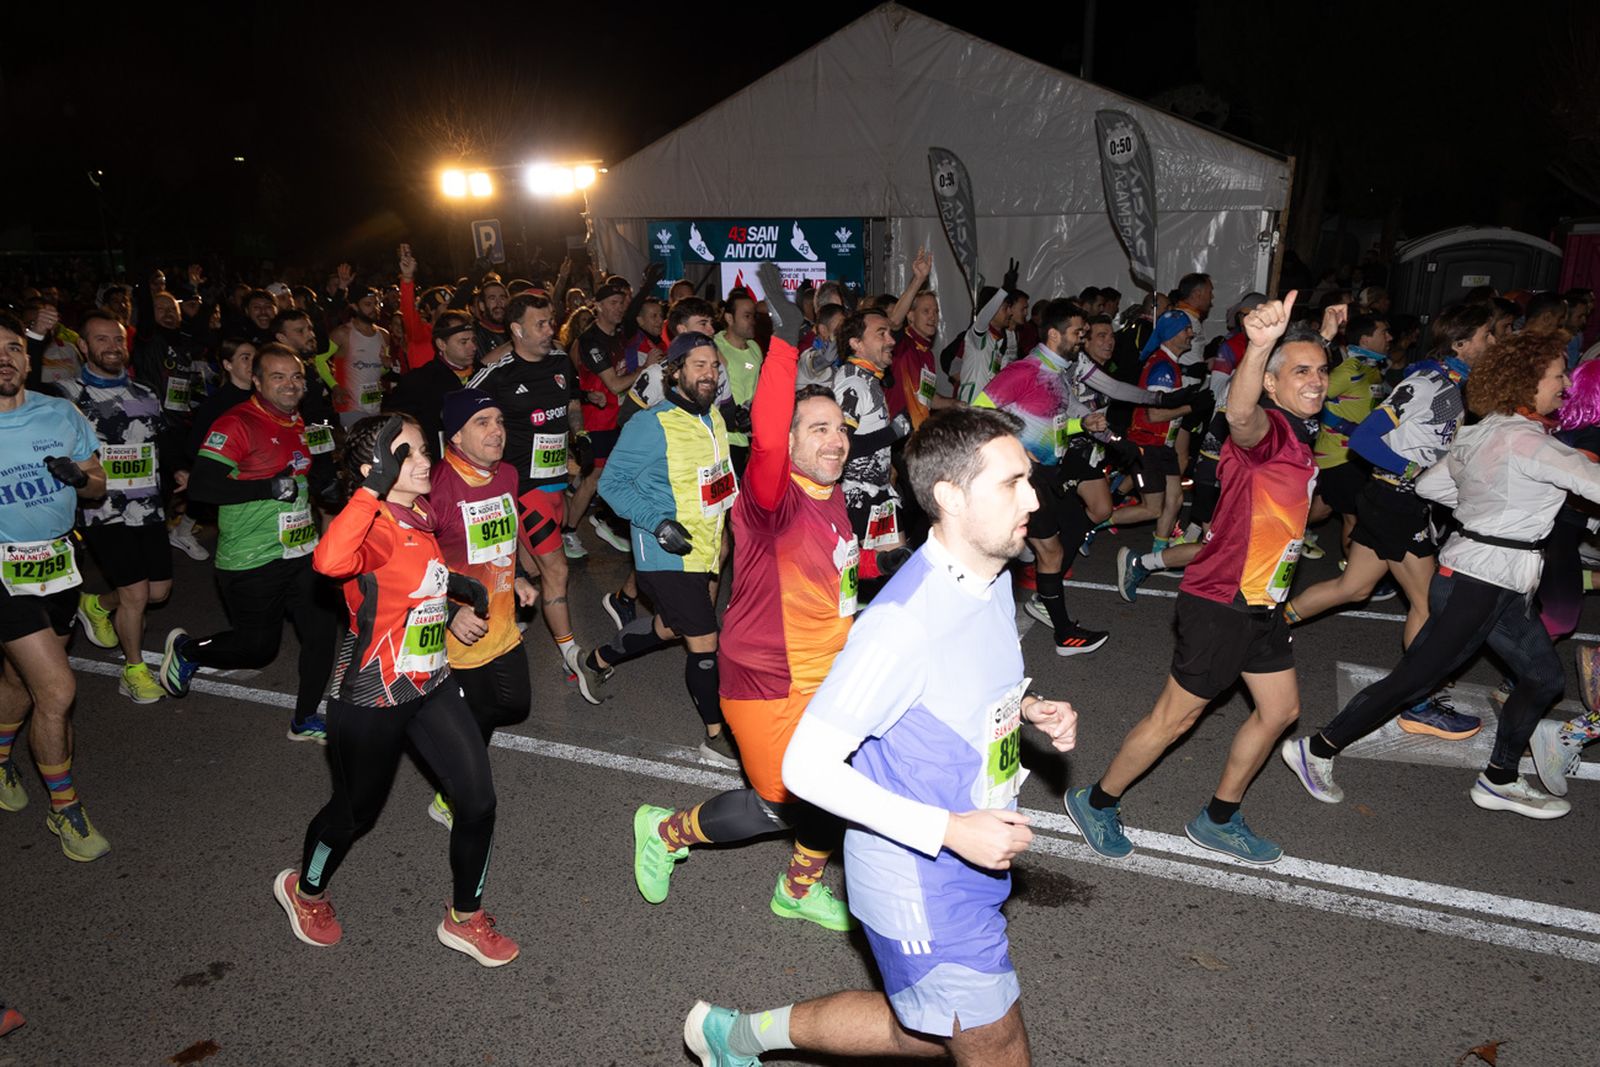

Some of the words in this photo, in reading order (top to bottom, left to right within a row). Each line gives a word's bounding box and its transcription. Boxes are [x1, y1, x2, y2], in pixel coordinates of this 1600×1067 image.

[1109, 136, 1132, 156] 0:50
[479, 225, 497, 254] P
[728, 225, 747, 243] 43
[747, 226, 779, 241] SAN
[724, 239, 777, 258] ANTÓN
[532, 413, 546, 423] TD
[545, 405, 567, 421] SPORT
[112, 459, 146, 475] 6067
[481, 517, 511, 541] 9211
[12, 553, 66, 578] 12759
